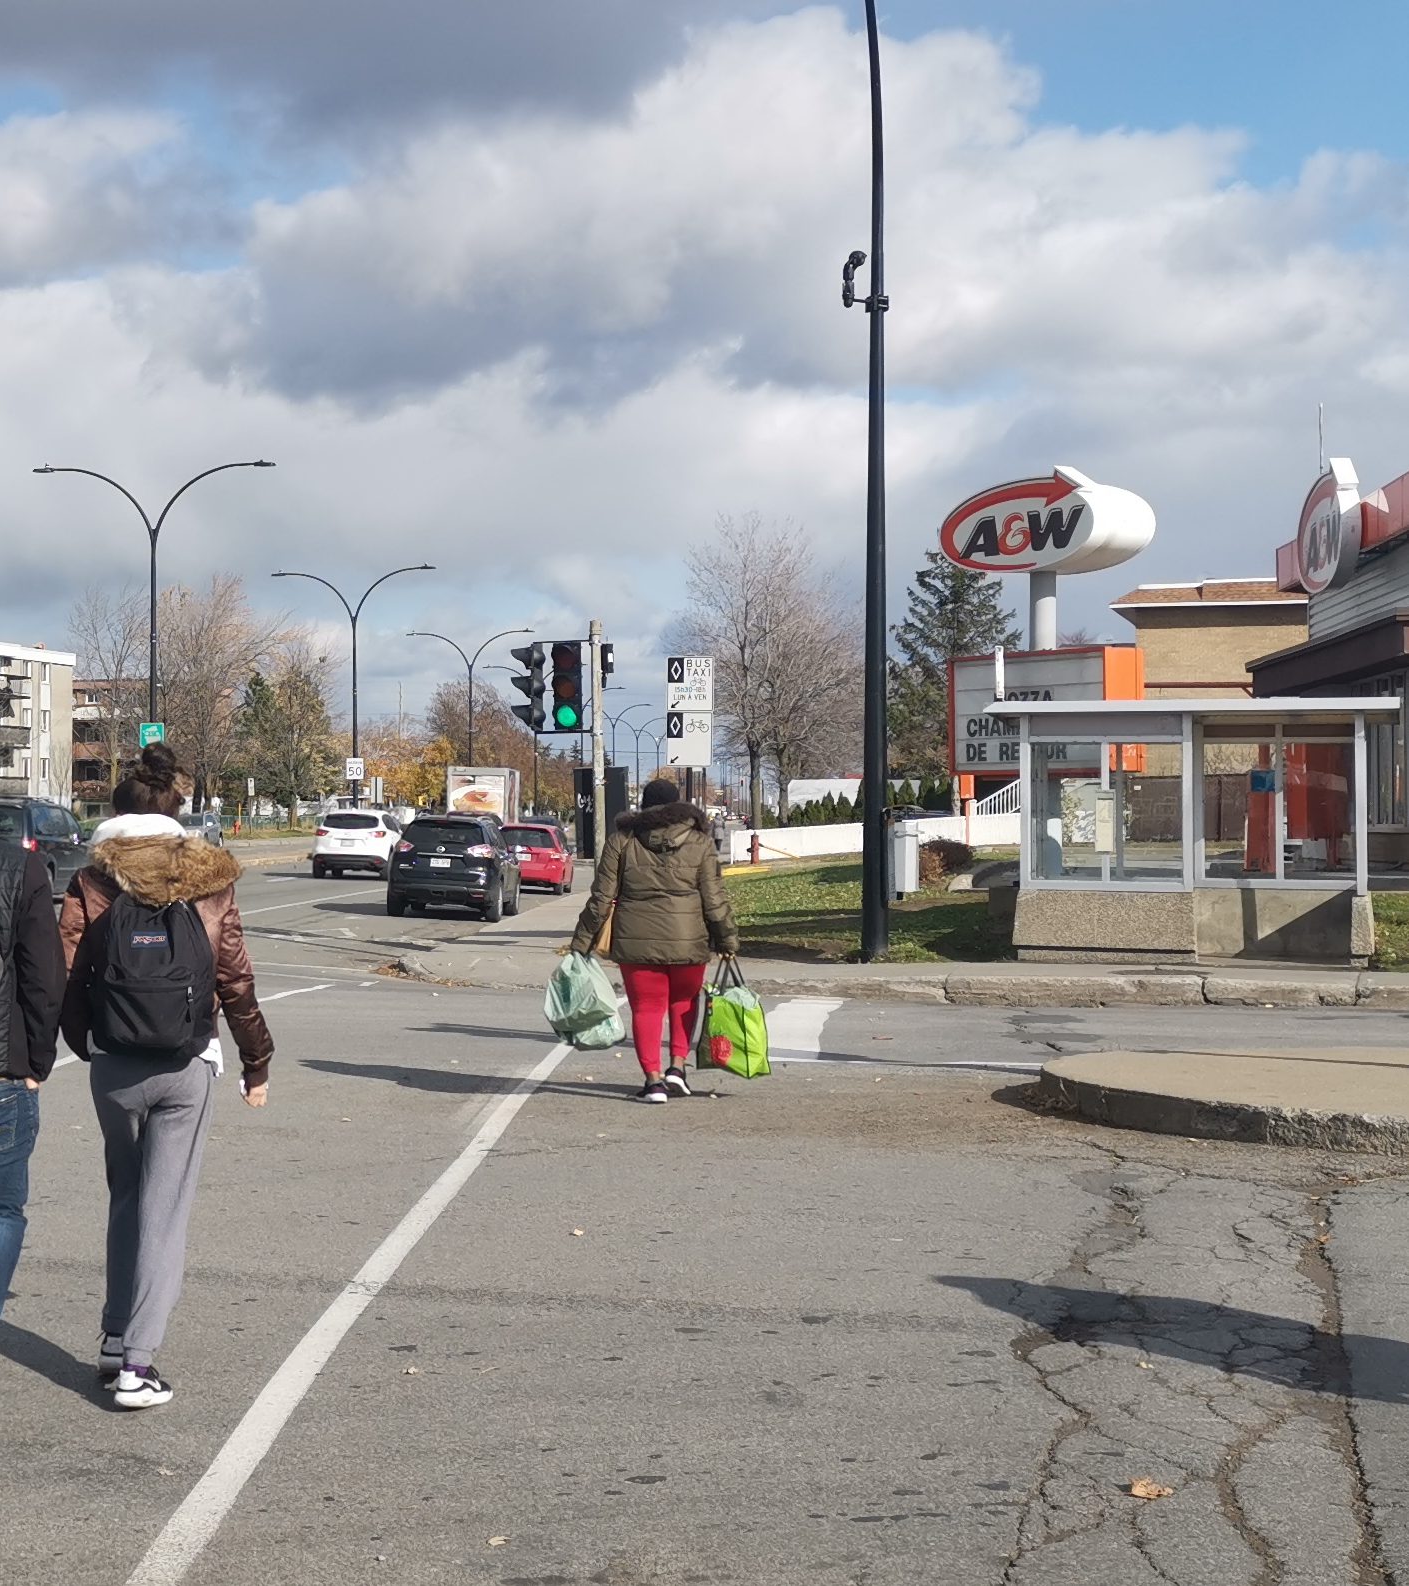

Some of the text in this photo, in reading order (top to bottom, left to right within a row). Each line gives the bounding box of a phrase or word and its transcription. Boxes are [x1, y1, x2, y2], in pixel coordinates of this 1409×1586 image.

[959, 504, 1086, 559] A&W
[1307, 507, 1341, 577] A&W
[686, 659, 711, 668] BUS
[687, 668, 711, 677] TAXI
[966, 742, 1068, 762] DE REUR
[348, 766, 362, 777] 50
